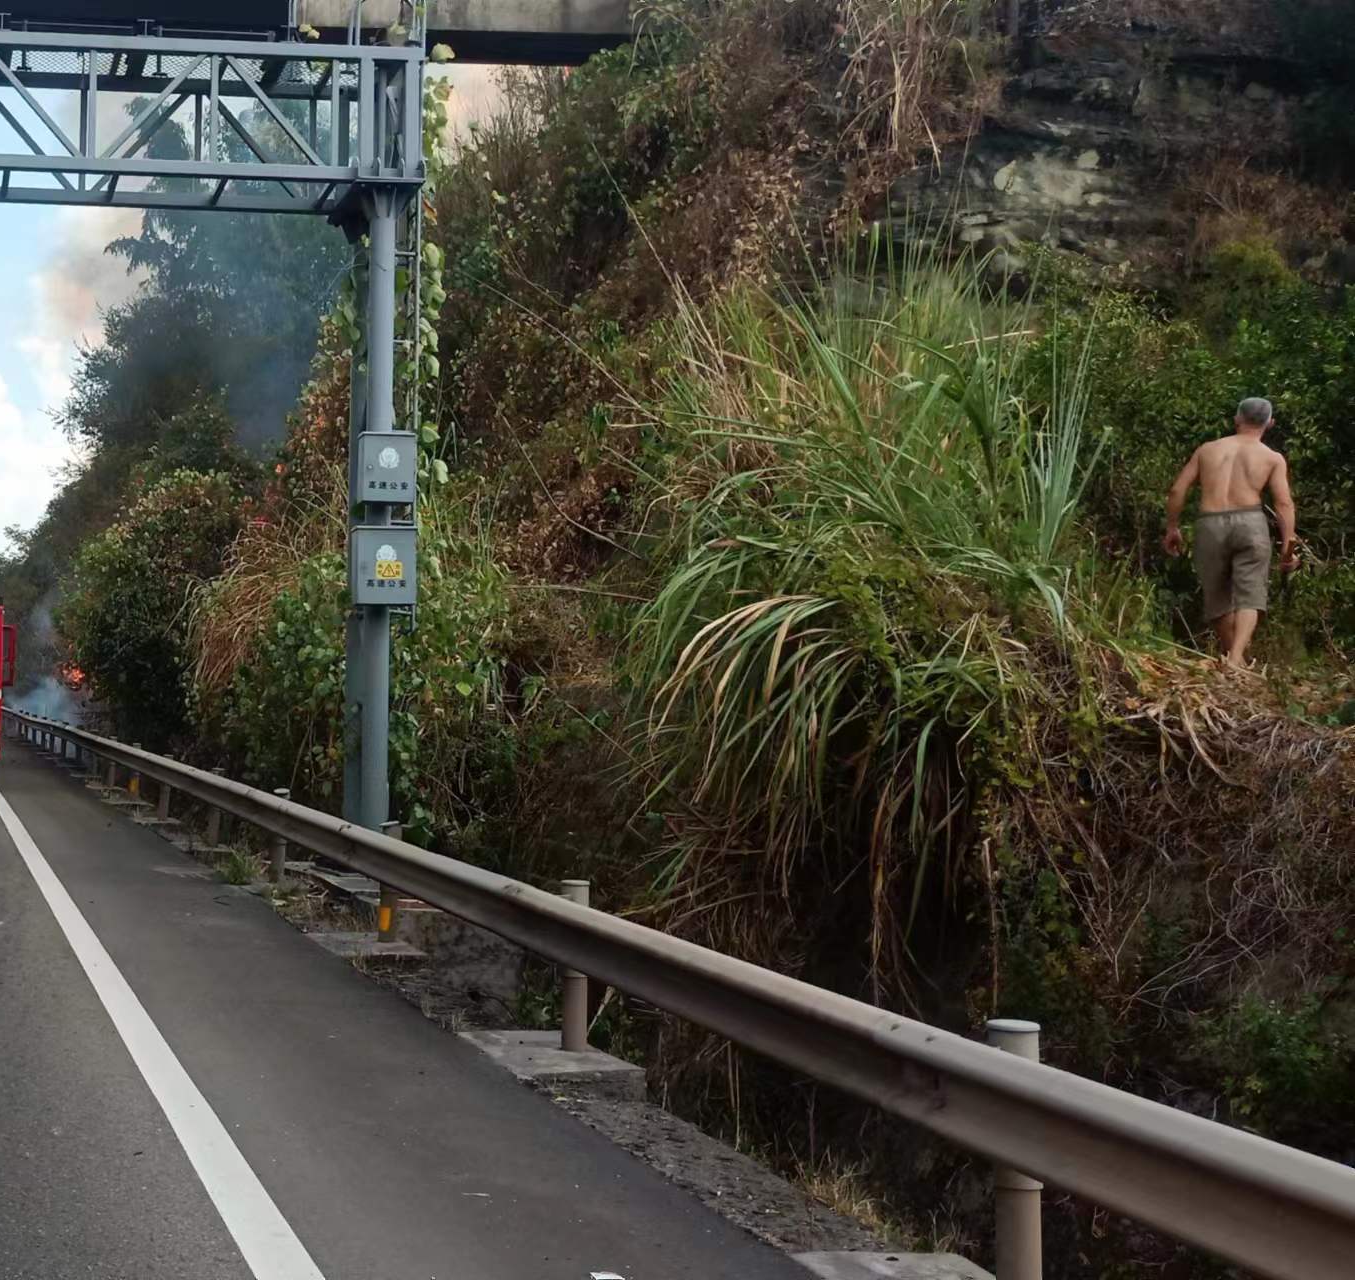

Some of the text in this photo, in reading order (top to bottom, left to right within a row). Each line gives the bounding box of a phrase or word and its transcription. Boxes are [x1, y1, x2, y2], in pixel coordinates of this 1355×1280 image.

[368, 480, 409, 490] 高速公安
[366, 579, 407, 588] 高速公安
